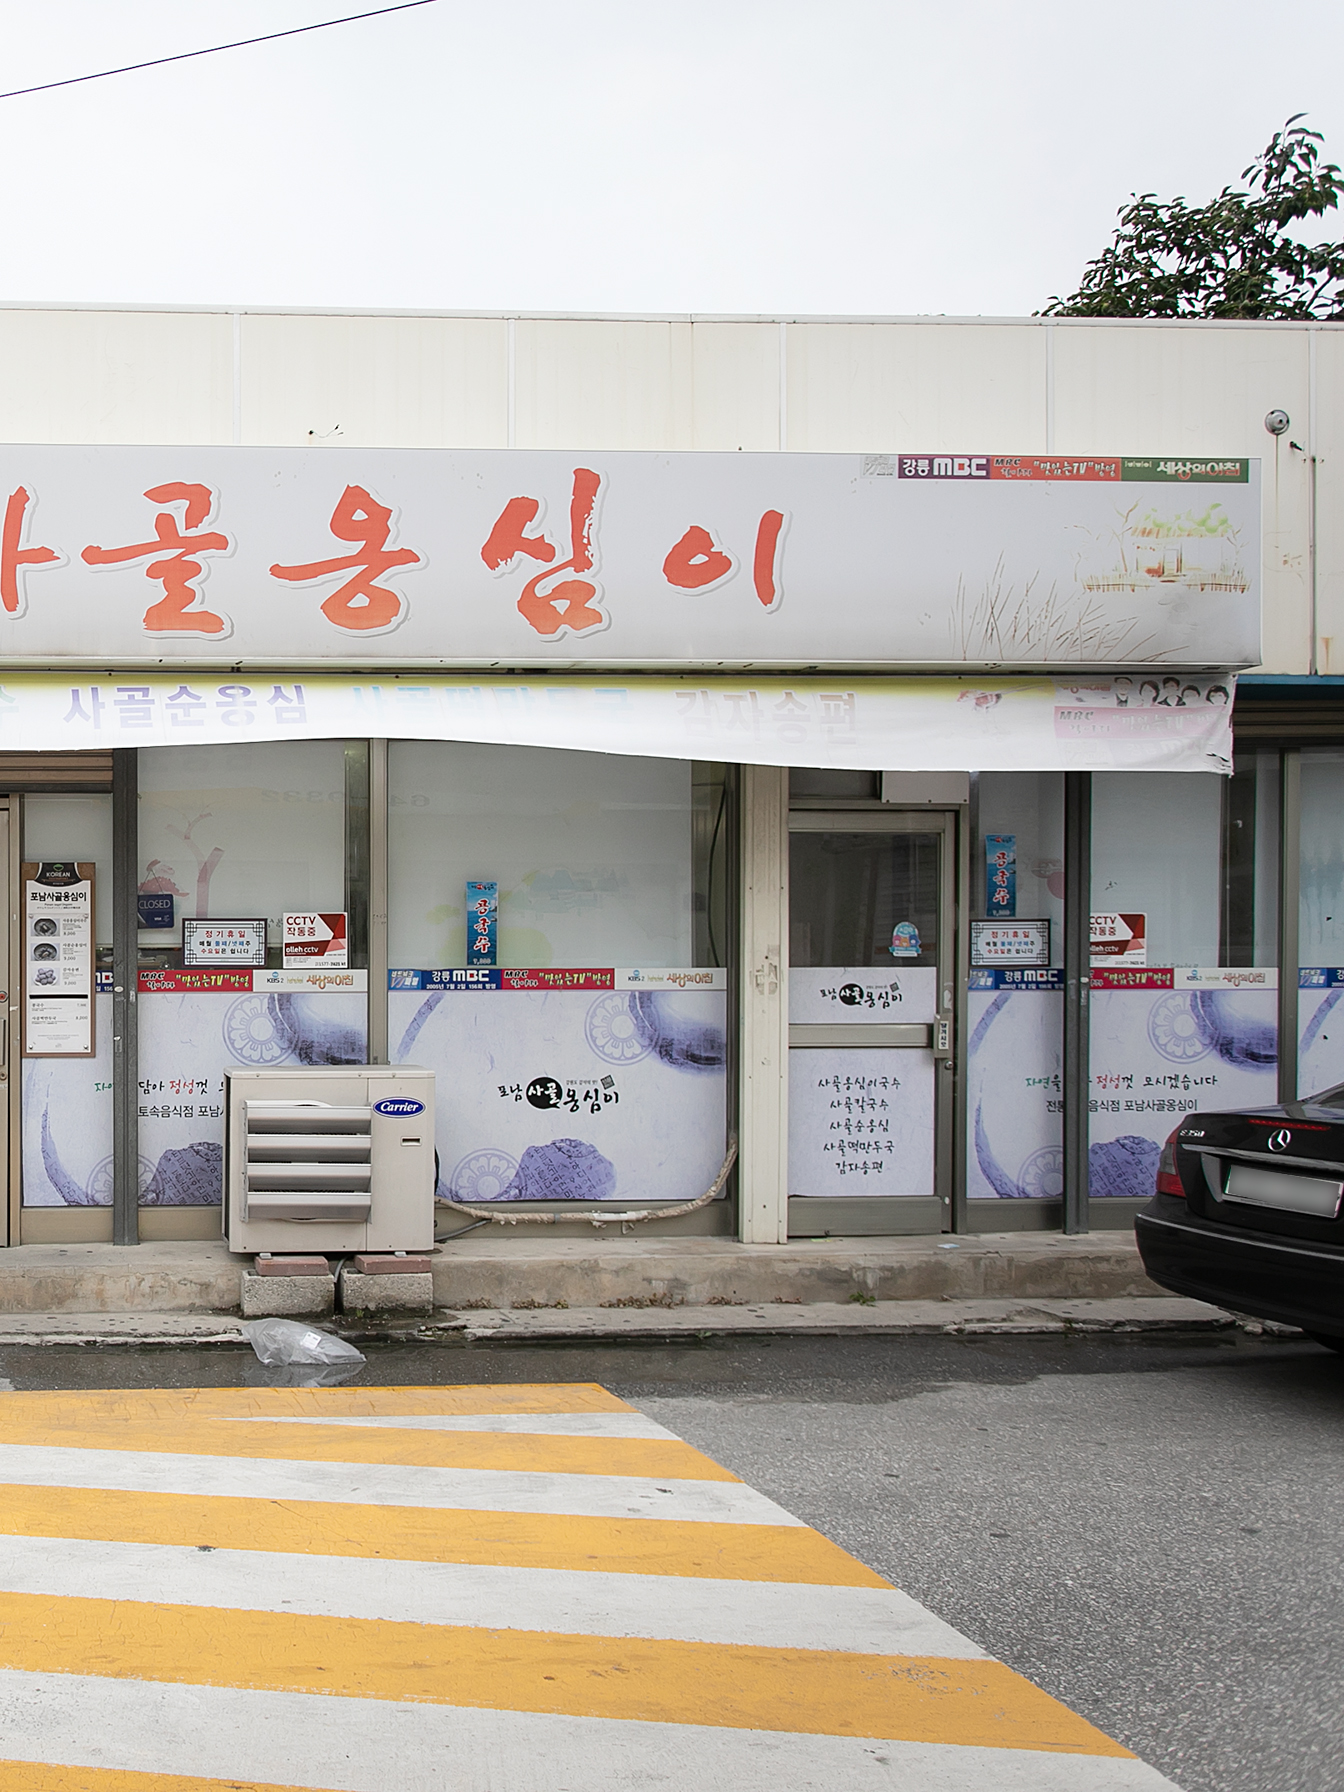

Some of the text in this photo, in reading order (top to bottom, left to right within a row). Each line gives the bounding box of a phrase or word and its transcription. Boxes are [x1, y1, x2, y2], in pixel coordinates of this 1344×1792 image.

[903, 458, 929, 476] 강릉
[933, 457, 987, 476] MBC
[62, 684, 308, 730] 사골순옹심
[138, 899, 171, 910] CLOSED
[286, 916, 316, 926] CCTV
[287, 927, 316, 936] 작동중
[431, 969, 490, 982] 강릉 MBC
[1004, 971, 1022, 982] 강릉
[1024, 970, 1058, 982] MBC
[138, 1079, 208, 1095] 담아 정성껏
[818, 1075, 902, 1093] 사골옹심이국수
[1096, 1074, 1134, 1090] 정성껏
[1142, 1074, 1219, 1091] 모시겠습니다
[138, 1105, 194, 1118] 토속음식점
[379, 1100, 419, 1114] Carrier
[830, 1096, 890, 1114] 사골칼국수
[1123, 1099, 1198, 1112] 포남사골옹심이
[829, 1118, 890, 1136] 사골순옹심
[823, 1140, 895, 1158] 사골떡만두국
[835, 1160, 884, 1175] 감자송편
